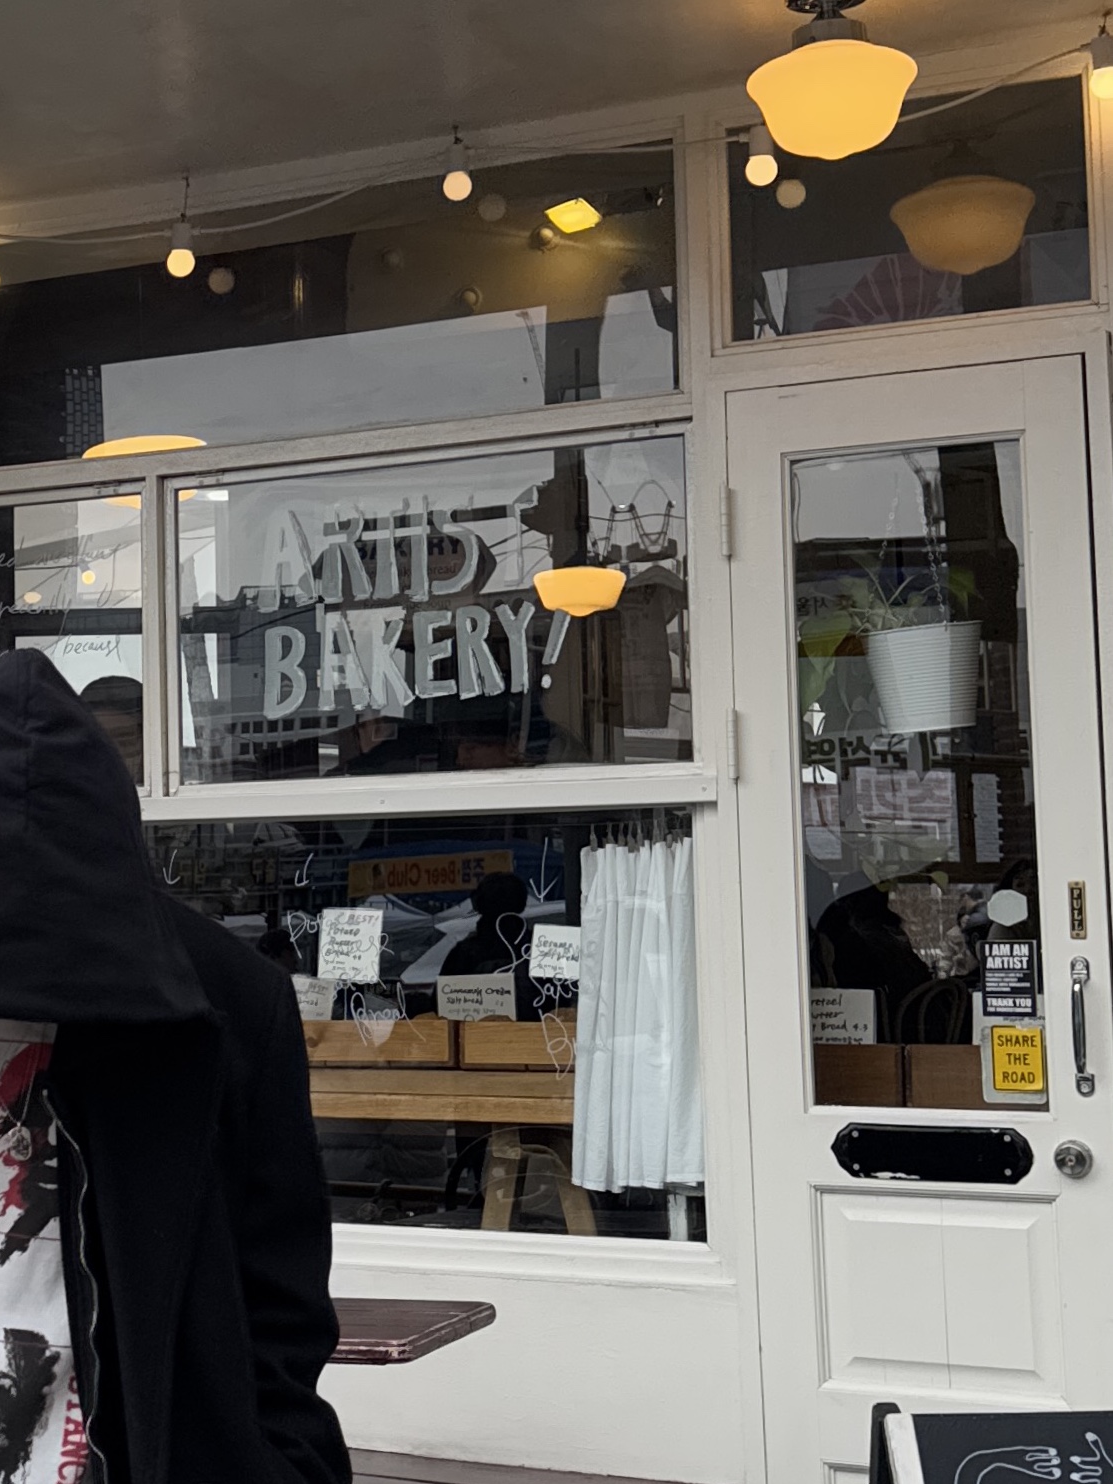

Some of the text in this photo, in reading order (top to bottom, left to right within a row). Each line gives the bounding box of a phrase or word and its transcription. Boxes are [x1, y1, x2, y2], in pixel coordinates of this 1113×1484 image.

[257, 491, 539, 613] ARTIST
[263, 601, 570, 720] BAKERY!
[1072, 889, 1083, 931] PULL
[984, 943, 1030, 957] I AM AN
[986, 956, 1030, 970] ARTIST
[811, 993, 843, 1007] retzel
[986, 997, 1032, 1008] THANK YOU
[811, 1011, 844, 1020] utter
[997, 1034, 1038, 1048] SHARE
[1006, 1053, 1031, 1066] THE
[1002, 1071, 1036, 1084] ROAD
